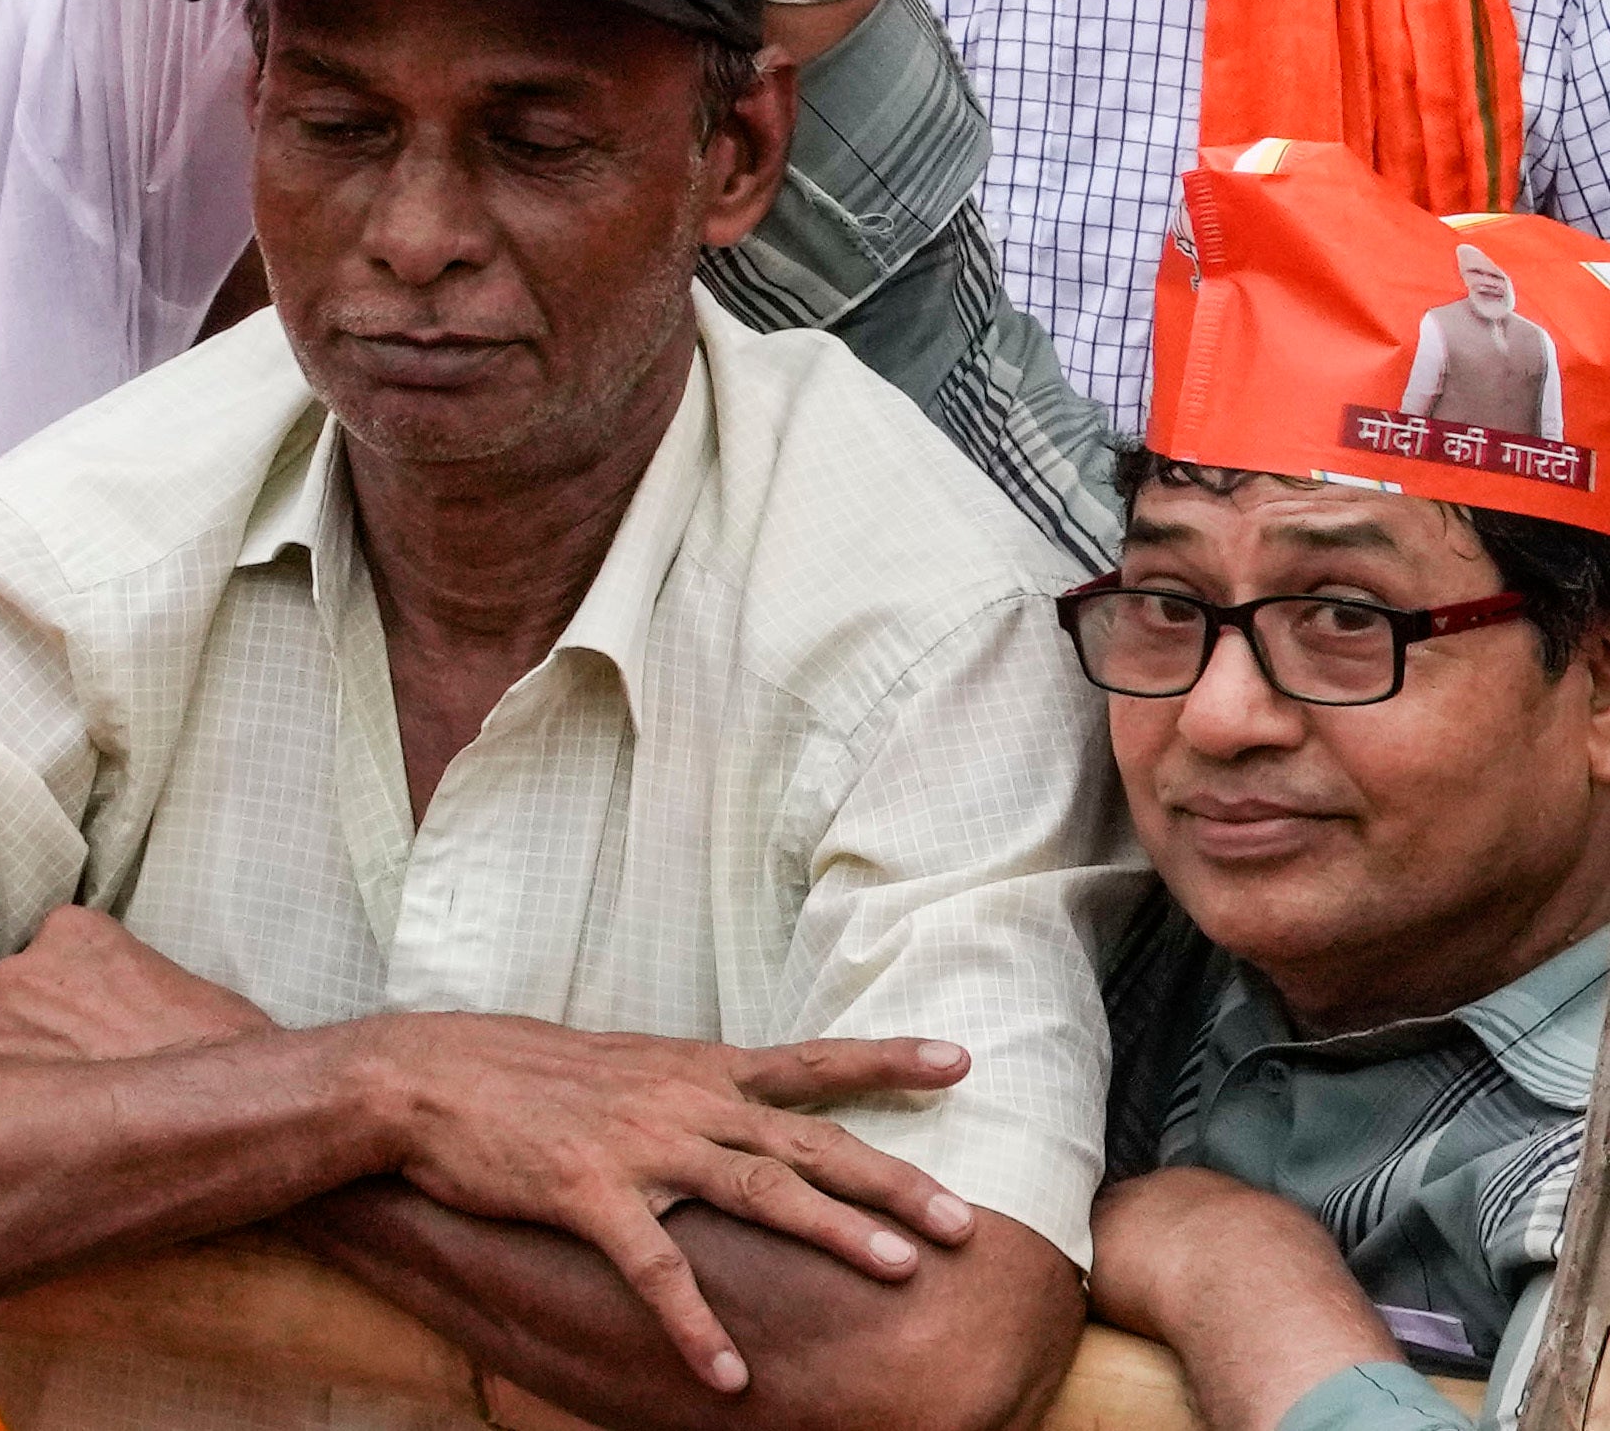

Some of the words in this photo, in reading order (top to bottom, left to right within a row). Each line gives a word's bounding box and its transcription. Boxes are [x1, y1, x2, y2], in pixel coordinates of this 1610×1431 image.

[1356, 411, 1430, 456] मोदी
[1443, 426, 1488, 466] की
[1500, 442, 1580, 485] गारंटी
